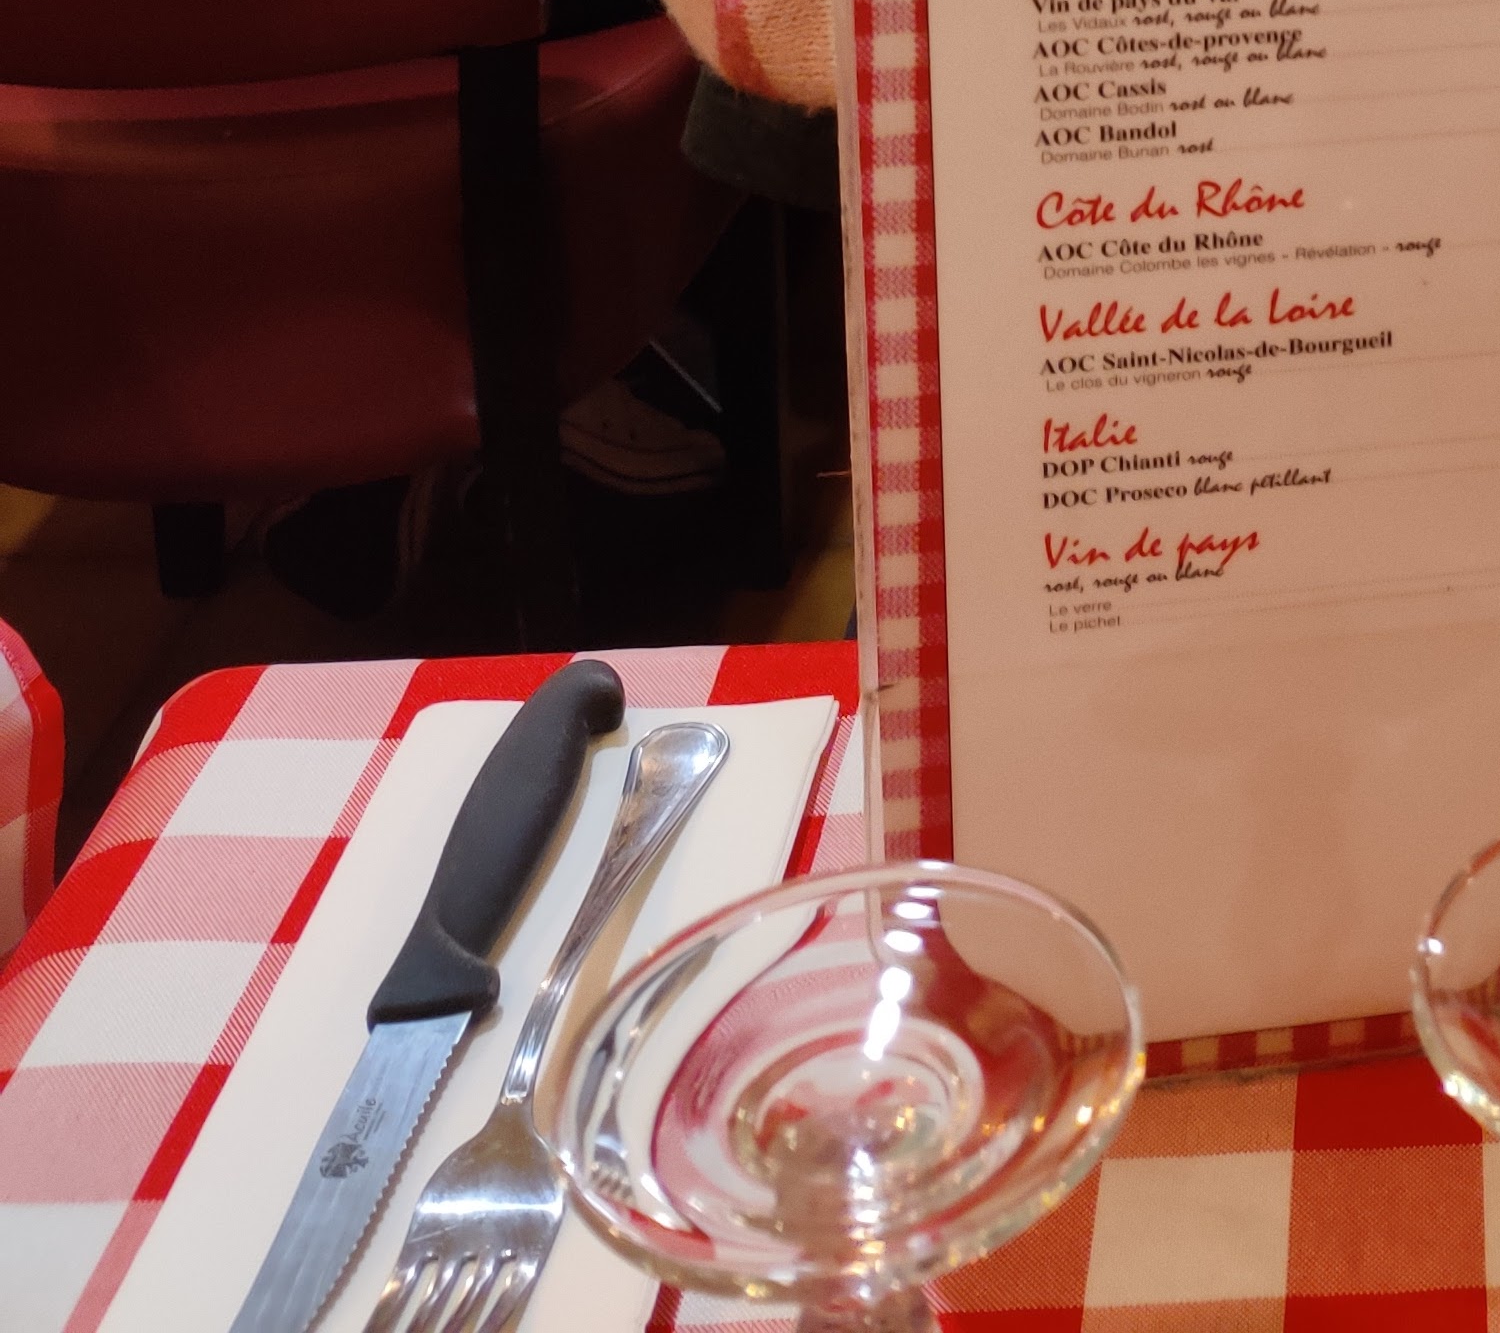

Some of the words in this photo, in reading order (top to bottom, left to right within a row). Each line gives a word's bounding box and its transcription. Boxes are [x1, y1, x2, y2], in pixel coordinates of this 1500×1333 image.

[1037, 17, 1068, 34] Les
[1072, 14, 1128, 31] Vidaux
[1185, 6, 1232, 28] rouge
[1240, 5, 1262, 19] ou
[1032, 39, 1089, 60] AOC
[1097, 27, 1303, 56] Côtes-de-provence
[1038, 61, 1060, 78] La
[1064, 57, 1135, 76] Rouvière
[1193, 50, 1239, 72] rouge
[1247, 49, 1270, 63] ou
[1277, 41, 1328, 63] blanc
[1034, 84, 1090, 104] AOC
[1097, 78, 1168, 99] Cassis
[1039, 103, 1112, 121] Domaine
[1117, 100, 1164, 116] Bodin
[1214, 94, 1236, 108] ou
[1244, 86, 1295, 107] blanc
[1035, 129, 1091, 148] AOC
[1099, 121, 1178, 143] Bandol
[1041, 147, 1113, 165] Domaine
[1118, 143, 1170, 160] Bunan
[1035, 191, 1117, 230] Côte
[1130, 186, 1180, 219] du
[1196, 177, 1306, 219] Rhône
[1037, 243, 1094, 263] AOC
[1100, 238, 1153, 258] Côte
[1158, 236, 1187, 254] du
[1194, 232, 1264, 251] Rhône
[1043, 262, 1115, 280] Domaine
[1119, 256, 1192, 276] Colombe
[1196, 252, 1219, 268] les
[1224, 250, 1276, 270] vignes
[1395, 237, 1442, 258] rouge
[1039, 300, 1148, 344] Vallée
[1160, 296, 1200, 331] de
[1214, 291, 1253, 328] la
[1268, 287, 1357, 326] Loire
[1039, 356, 1096, 377] AOC
[1101, 330, 1393, 372] Saint-Nicolas-de-Bourgueil
[1046, 376, 1064, 393] Le
[1070, 376, 1103, 391] clos
[1108, 372, 1128, 387] du
[1132, 365, 1202, 388] vigneron
[1207, 362, 1253, 384] rouge
[1042, 412, 1139, 455] Italie
[1042, 458, 1095, 480] DOP
[1100, 451, 1182, 475] Chianti
[1186, 449, 1235, 472] rouge
[1042, 490, 1098, 510] DOC
[1105, 483, 1188, 505] Proseco
[1193, 476, 1243, 496] blanc
[1043, 532, 1110, 569] Vin
[1124, 526, 1164, 561] de
[1177, 530, 1260, 571] pays
[1093, 570, 1139, 593] rouge
[1146, 569, 1168, 583] ou
[1175, 562, 1225, 582] blanc
[1048, 601, 1068, 617] Le
[1072, 598, 1112, 613] verre
[1049, 617, 1068, 633] Le
